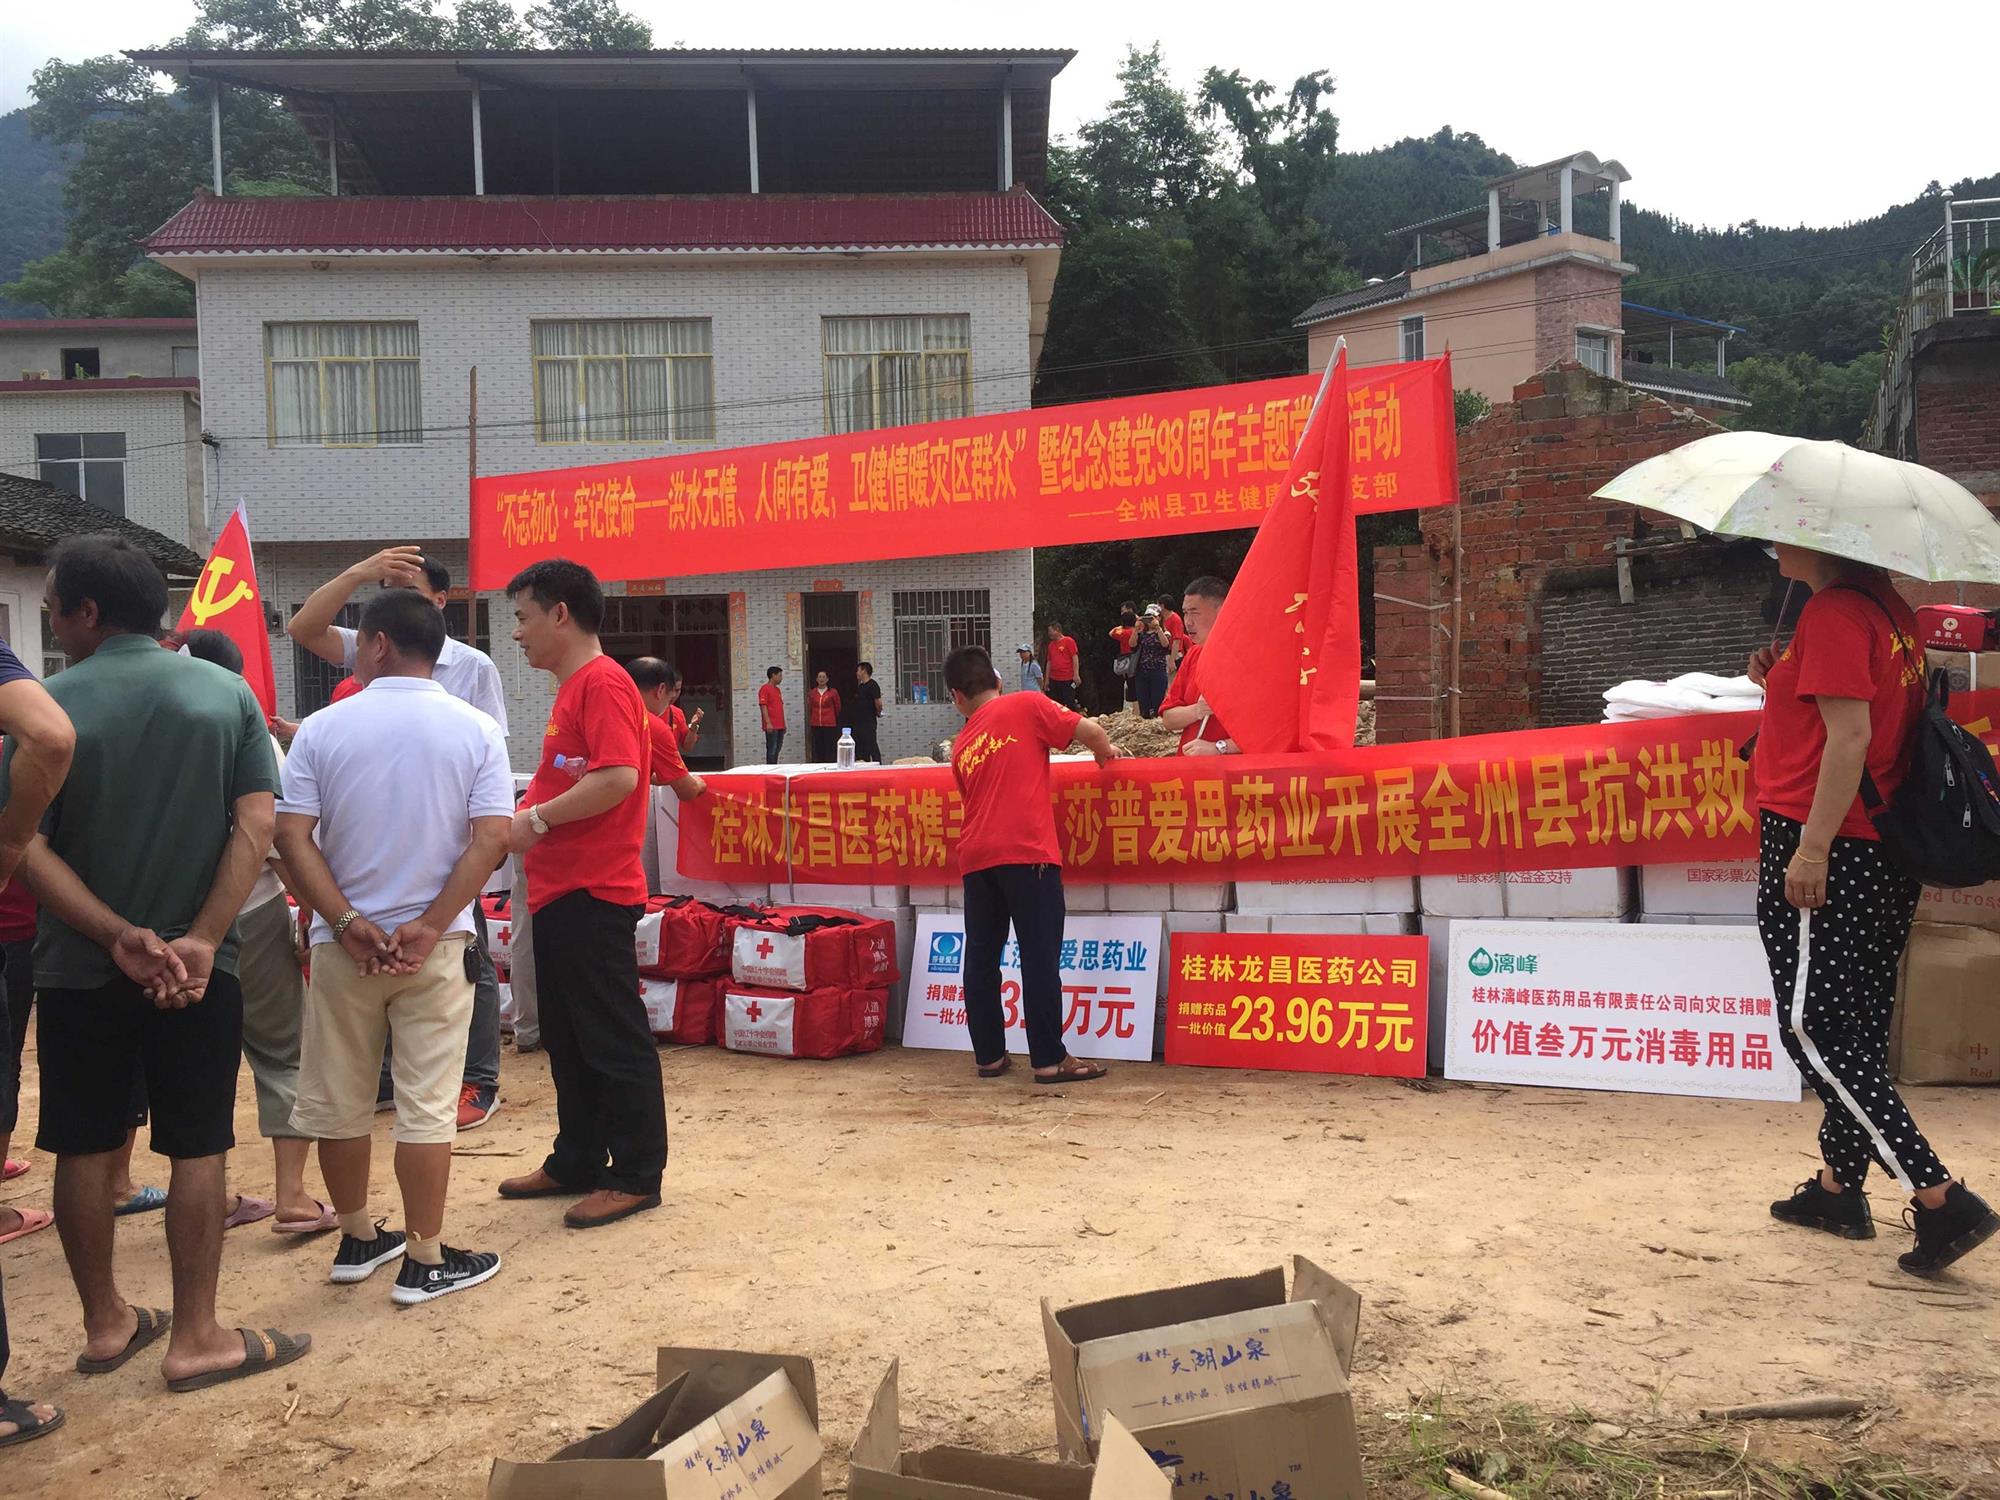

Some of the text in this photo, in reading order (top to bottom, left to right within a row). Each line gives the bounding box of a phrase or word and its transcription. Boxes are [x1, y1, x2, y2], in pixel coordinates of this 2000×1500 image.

[1068, 470, 1398, 523] ——全州县卫生健康支部
[710, 738, 1756, 867] 桂林龙昌医药携莎普爱思药业开展全州县抗洪救
[1922, 888, 1944, 903] ed
[1180, 953, 1418, 988] 桂林龙昌医药公司
[1494, 952, 1539, 975] 漓峰
[1177, 1001, 1227, 1018] 捐赠药品
[1472, 986, 1772, 1017] 桂林漓峰医药用品有限责任公司向灾区捐赠
[1176, 1021, 1226, 1037] 一批价值
[1229, 994, 1415, 1053] 23.96万元
[1472, 1018, 1774, 1072] 价值叁万元消毒用品
